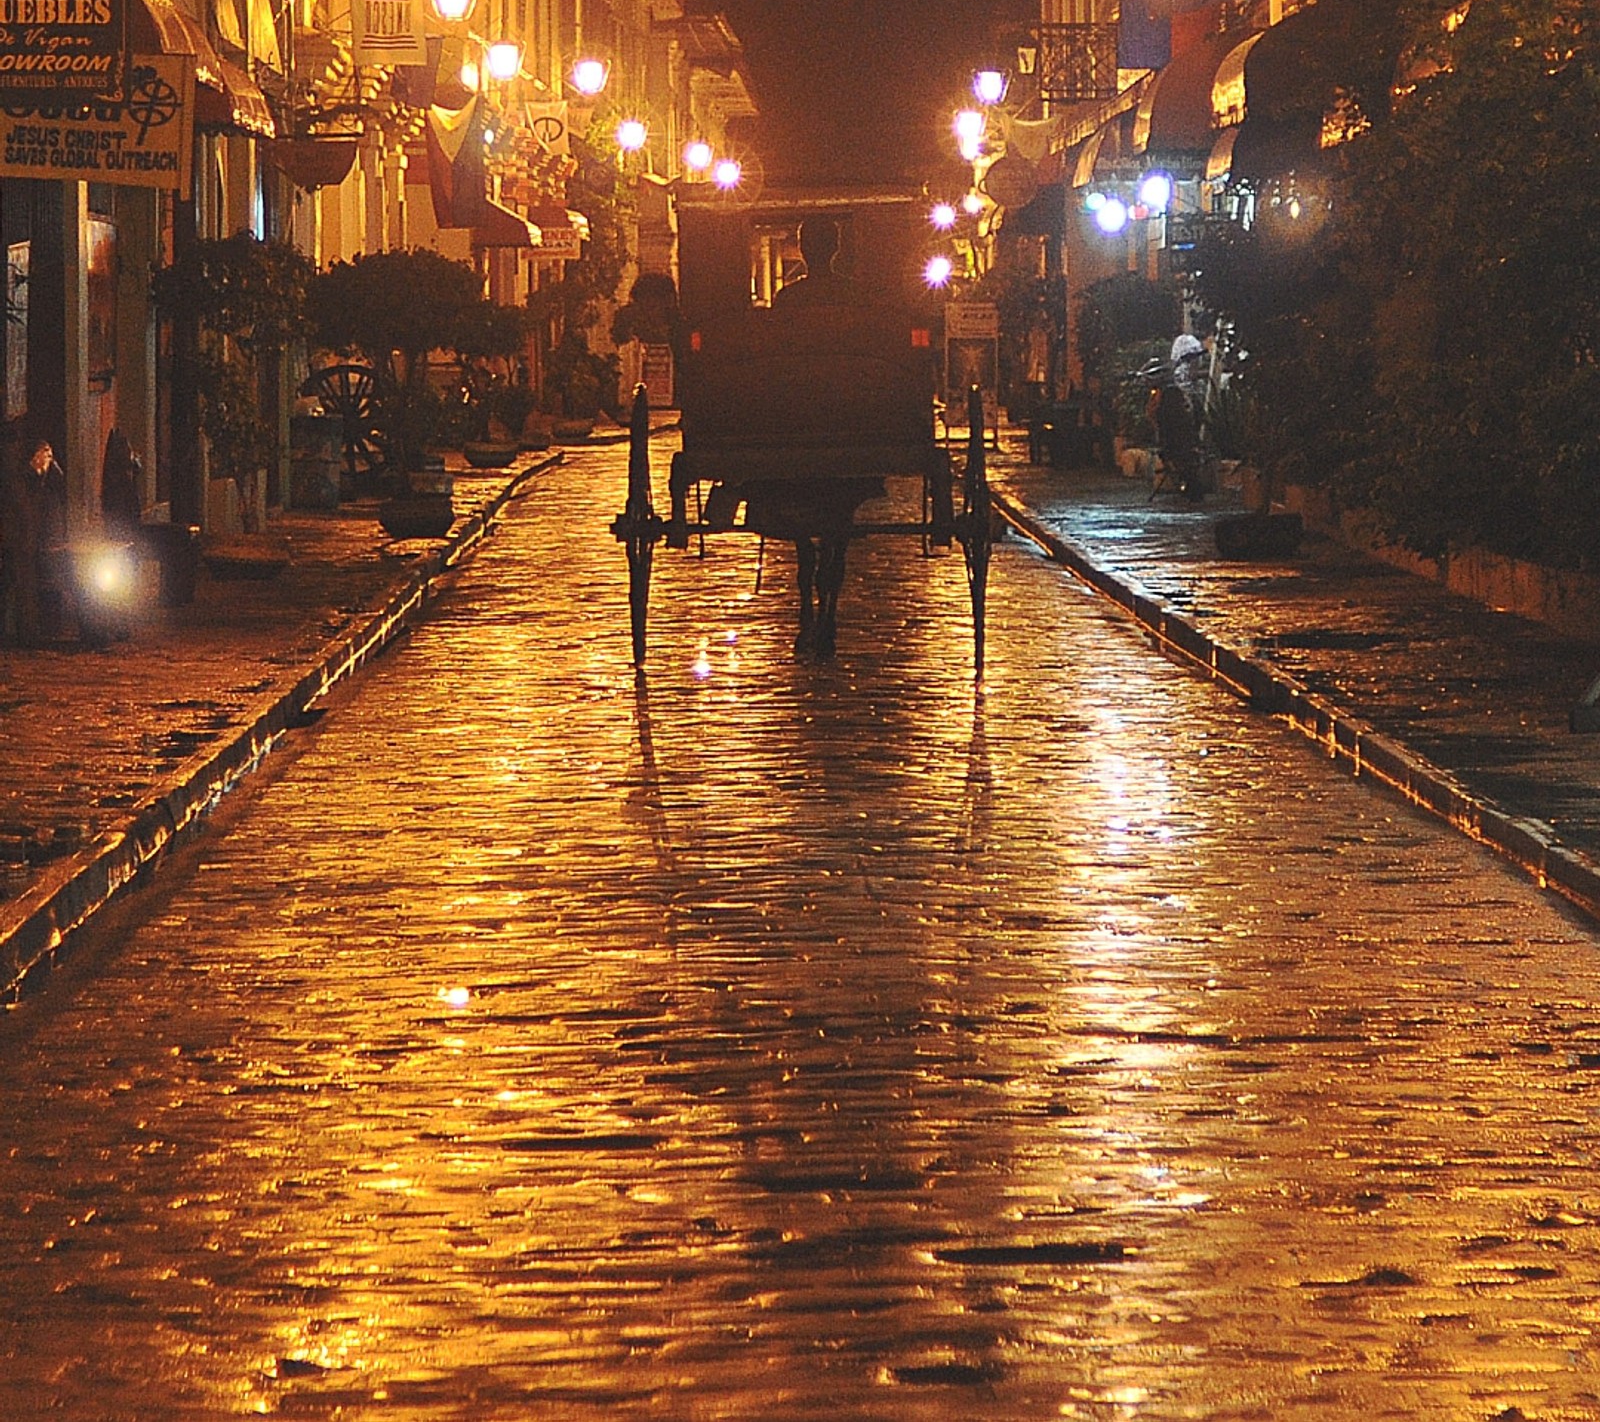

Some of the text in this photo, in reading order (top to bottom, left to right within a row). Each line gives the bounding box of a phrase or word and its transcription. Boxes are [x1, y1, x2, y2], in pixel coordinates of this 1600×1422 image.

[24, 27, 92, 53] Vigan
[7, 125, 127, 150] JESUS CHRIST
[5, 146, 177, 170] SAVES GLOBAL OUTREACH
